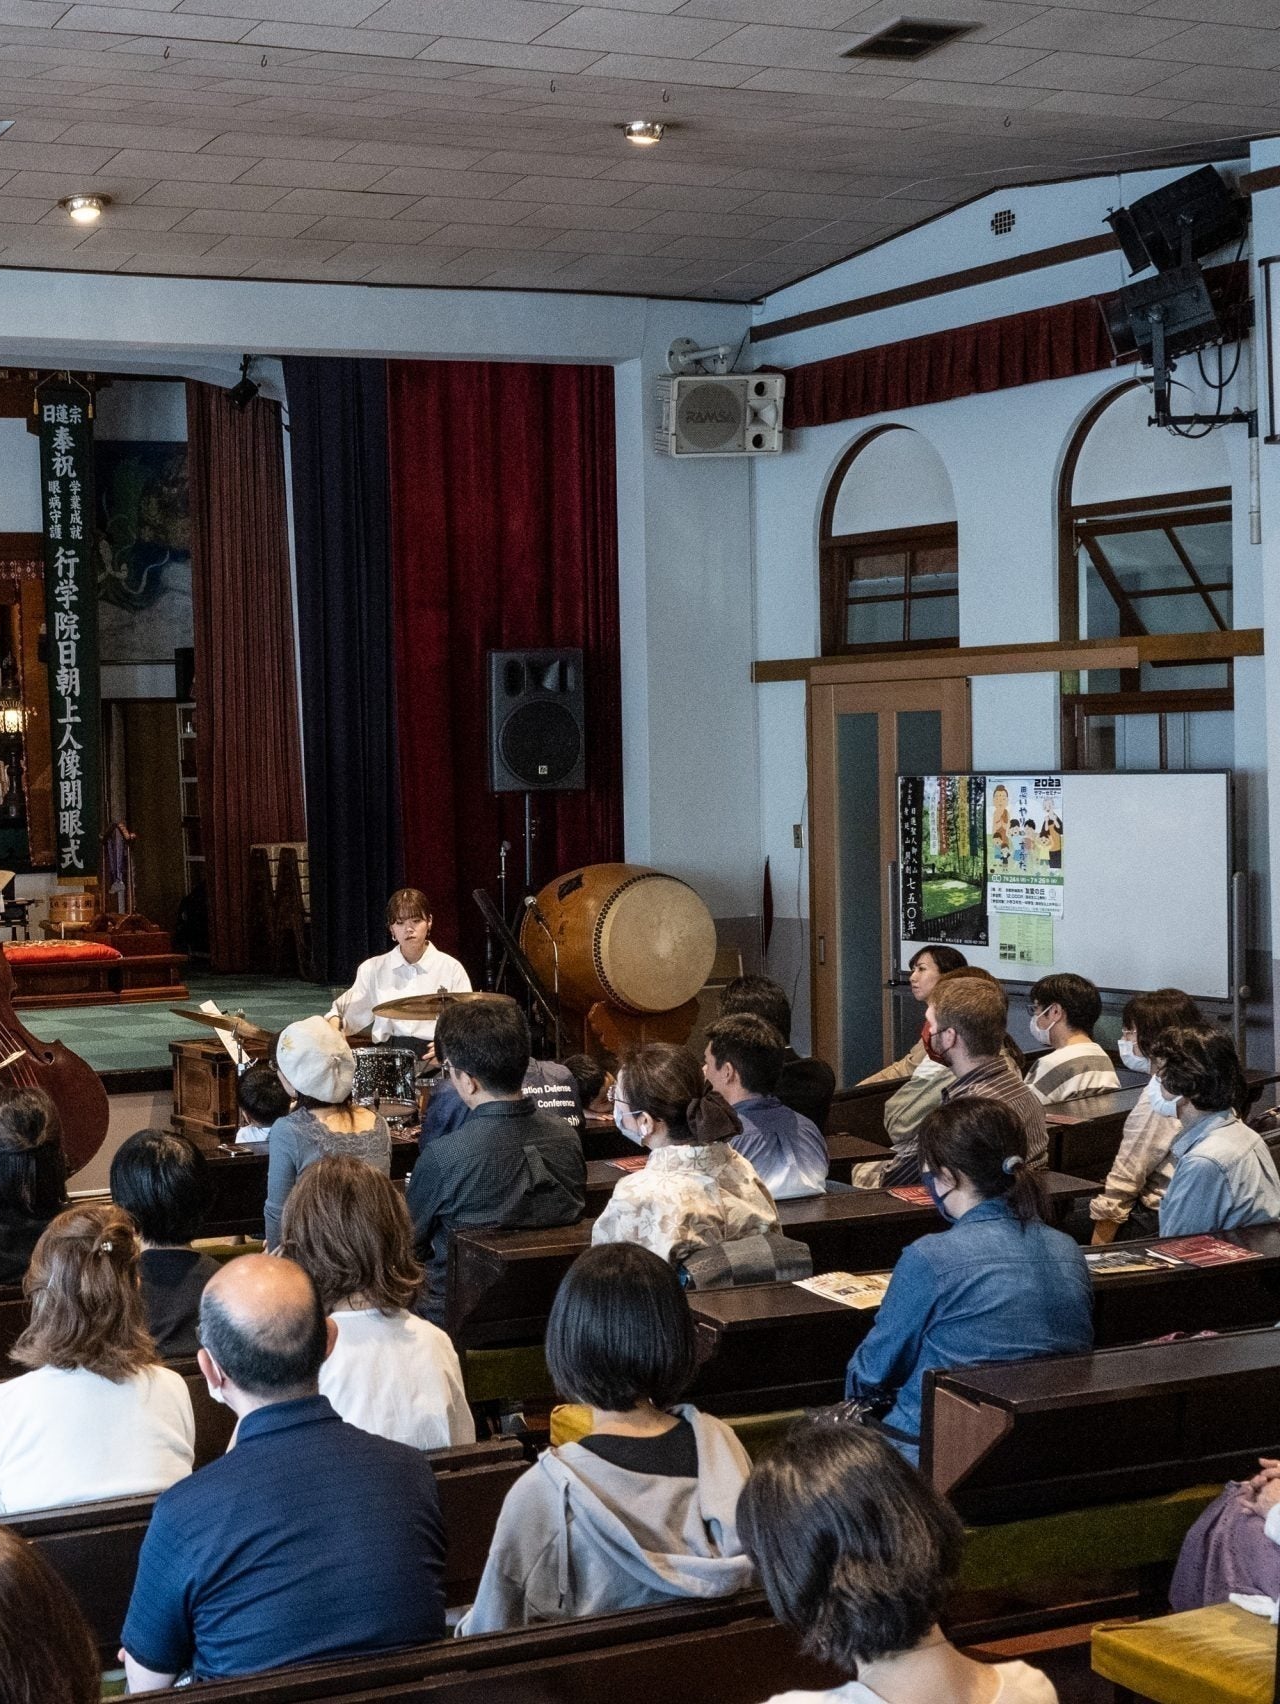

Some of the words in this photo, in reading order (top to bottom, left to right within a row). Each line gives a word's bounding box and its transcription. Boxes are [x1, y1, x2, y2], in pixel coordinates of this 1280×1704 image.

[43, 404, 82, 425] 日蓮宗
[52, 426, 77, 478] 奉祝
[48, 480, 62, 540] 眼病守護
[69, 480, 83, 540] 学業成就
[53, 547, 85, 870] 行学院日朝上人像開眼式
[1034, 778, 1061, 787] 2023
[537, 1099, 575, 1108] Conference
[544, 1084, 572, 1093] Defense
